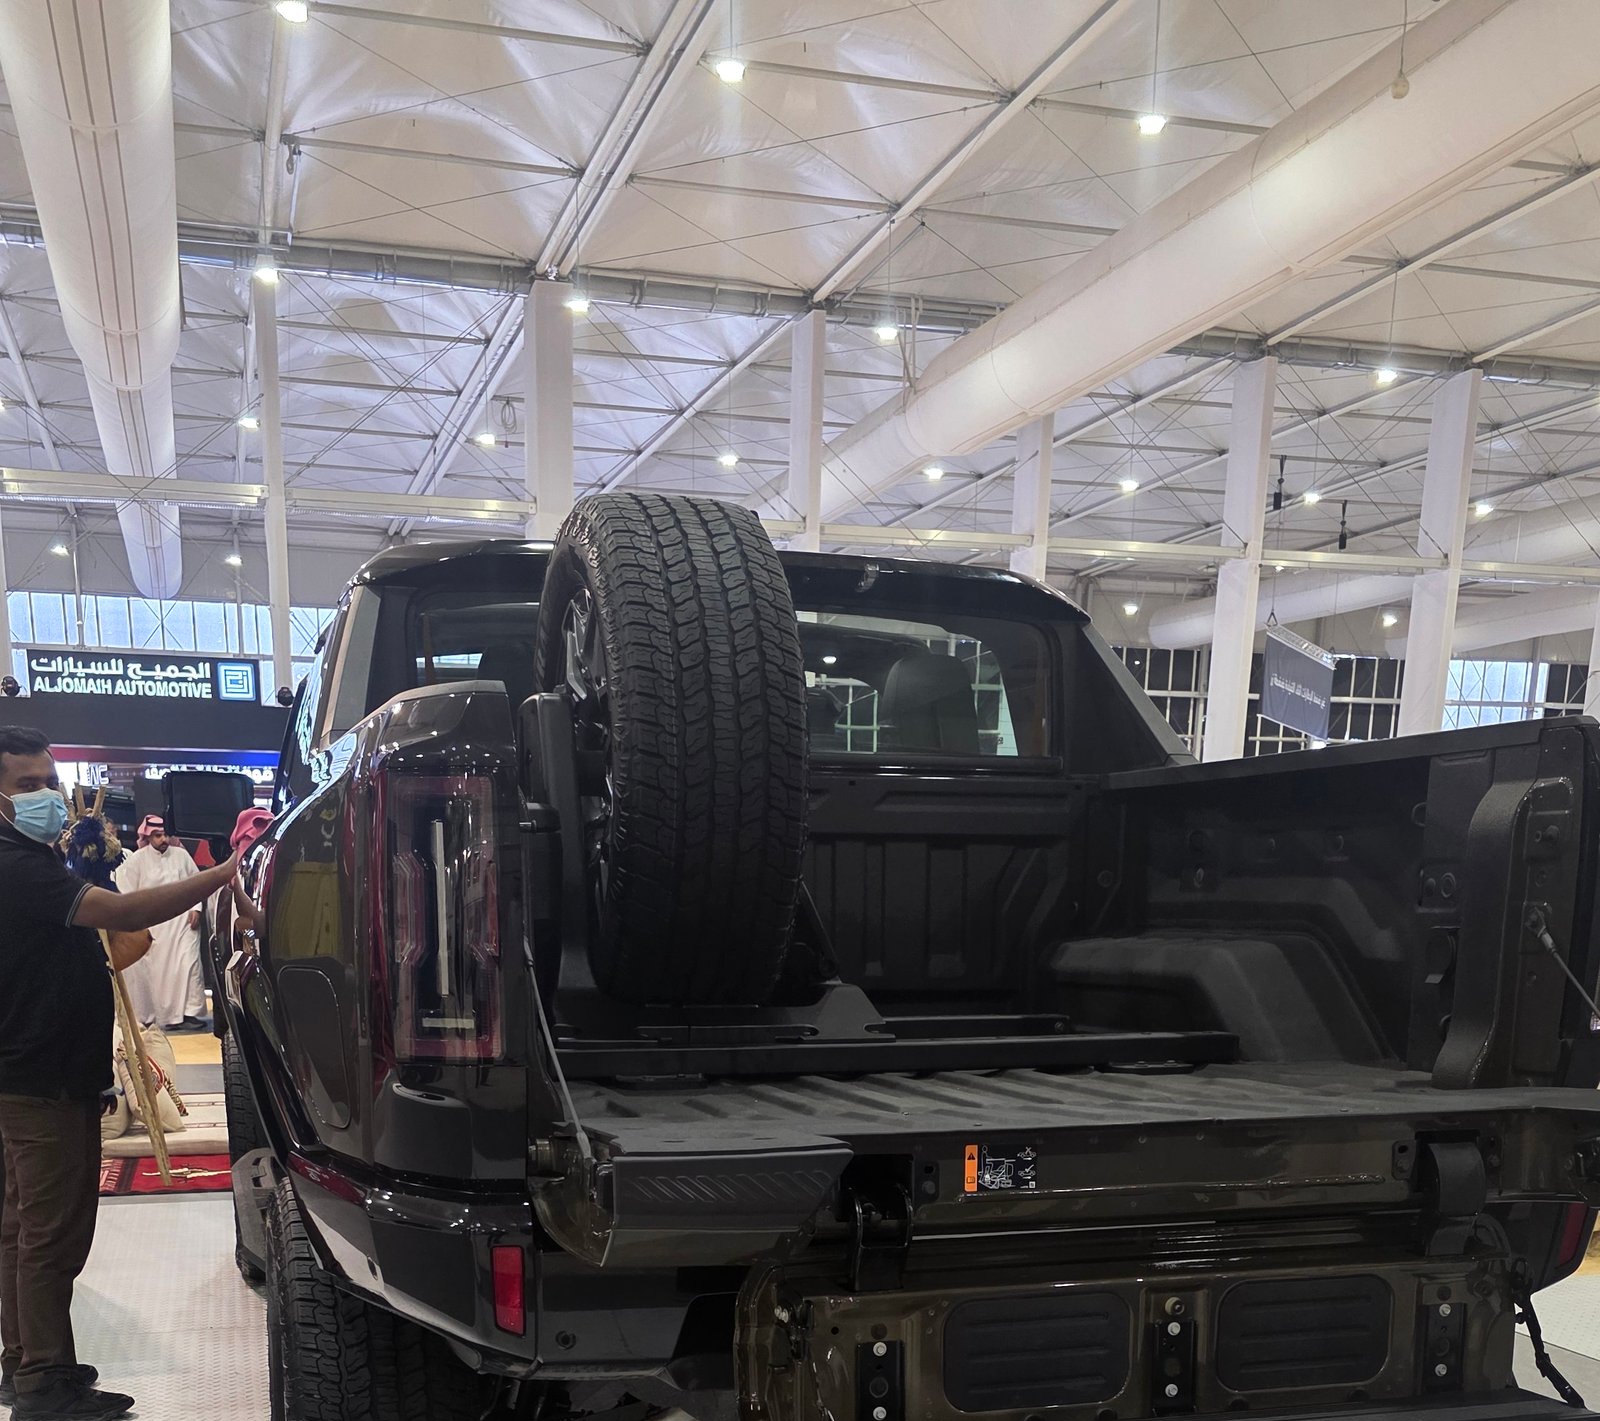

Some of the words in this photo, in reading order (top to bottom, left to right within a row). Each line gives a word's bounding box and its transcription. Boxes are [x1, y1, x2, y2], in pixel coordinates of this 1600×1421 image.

[30, 656, 124, 676] للسيارات
[127, 662, 211, 680] الجميح
[33, 676, 112, 695] ALJOMAIH
[114, 678, 213, 699] AUTOMOTIVE
